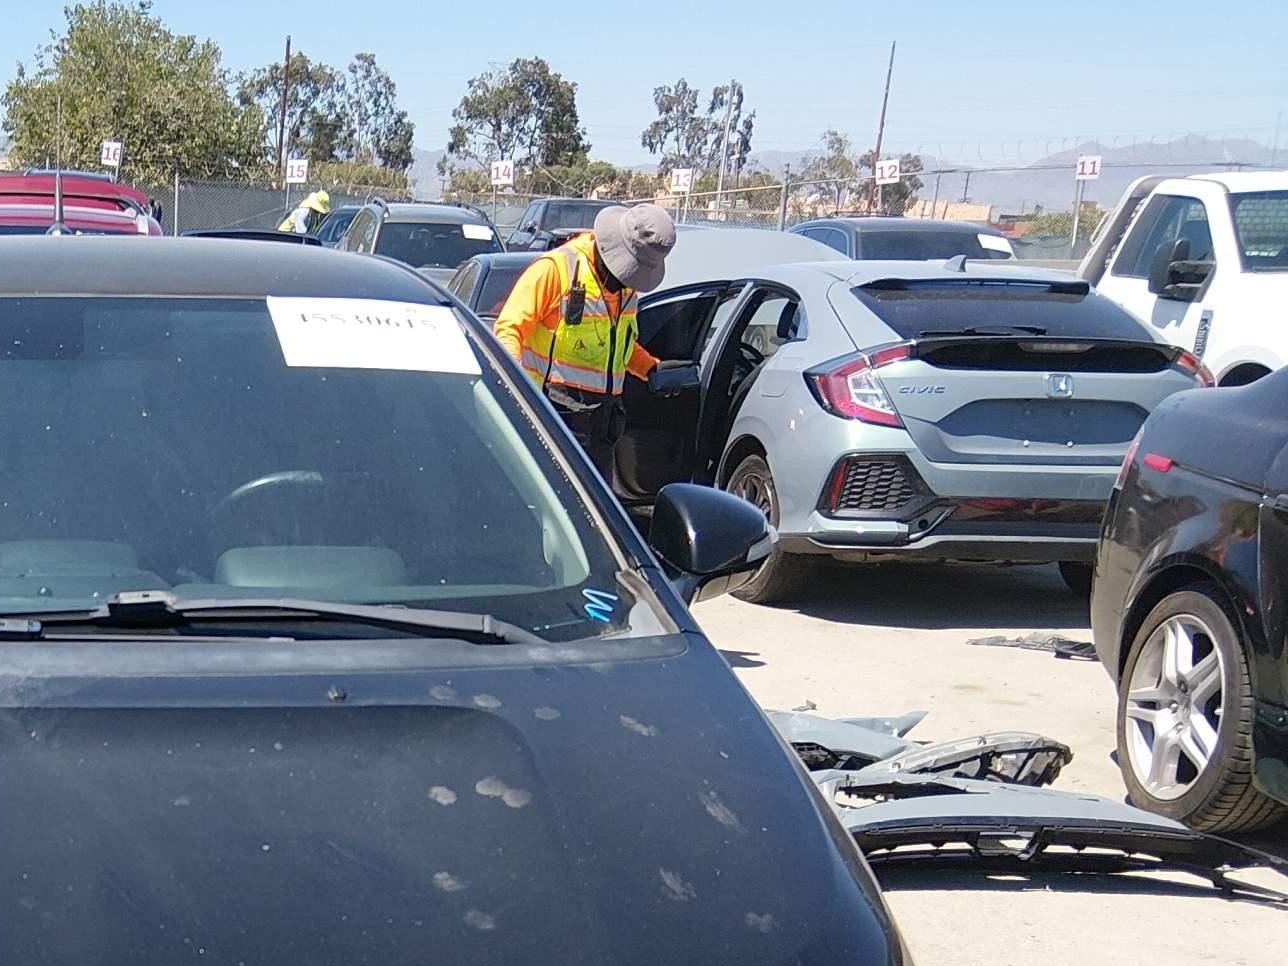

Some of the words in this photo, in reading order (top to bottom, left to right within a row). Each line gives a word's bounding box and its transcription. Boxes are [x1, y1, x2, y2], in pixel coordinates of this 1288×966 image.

[103, 147, 119, 161] 16
[288, 164, 305, 178] 15
[493, 165, 511, 180] 14
[877, 164, 898, 180] 12
[1077, 160, 1098, 176] 11
[672, 173, 690, 187] 13
[898, 385, 946, 394] CIVIC
